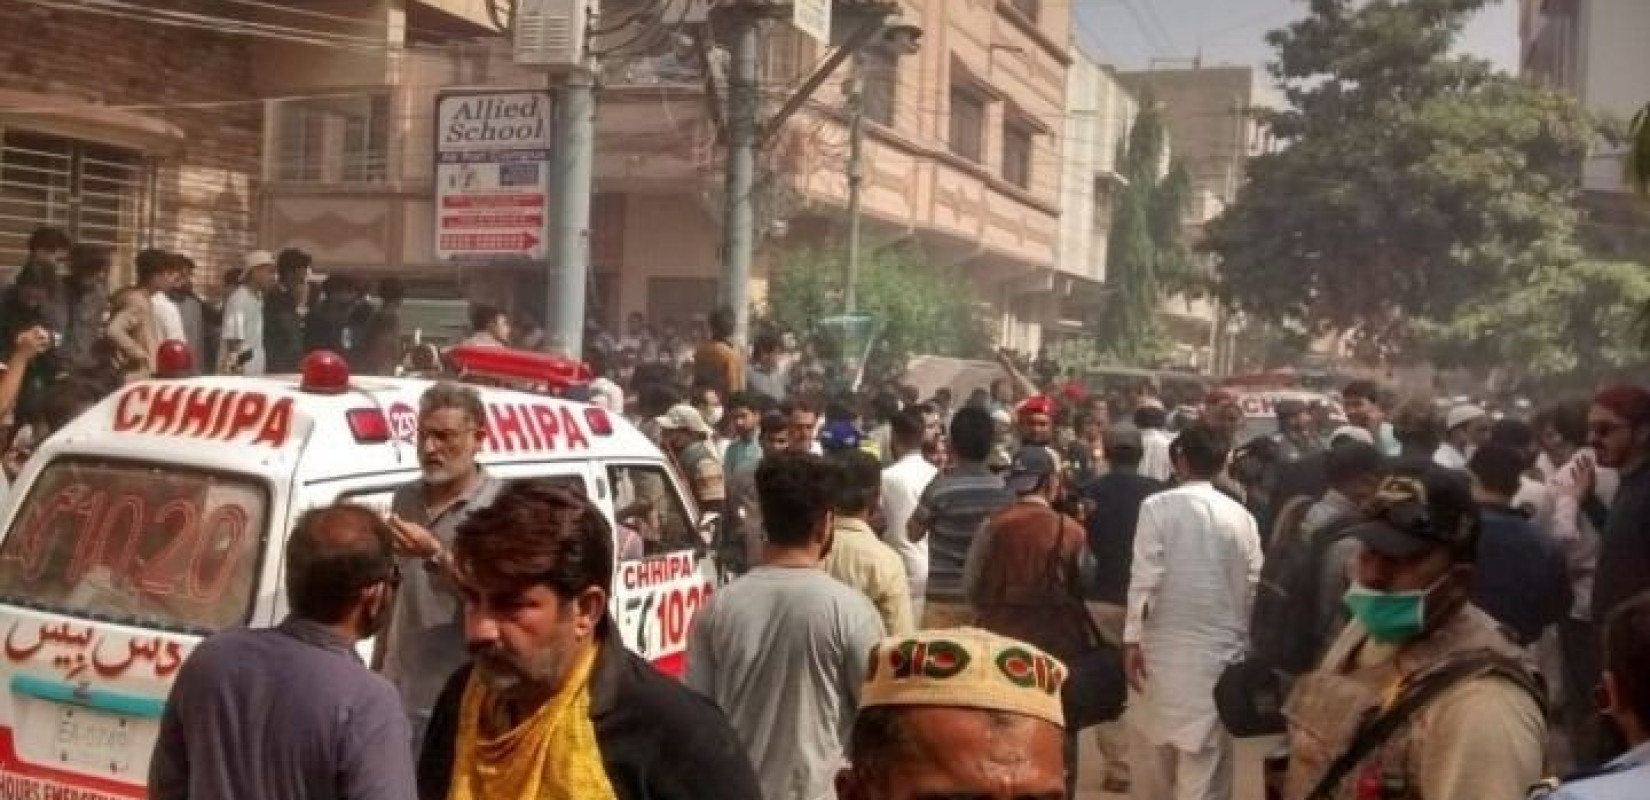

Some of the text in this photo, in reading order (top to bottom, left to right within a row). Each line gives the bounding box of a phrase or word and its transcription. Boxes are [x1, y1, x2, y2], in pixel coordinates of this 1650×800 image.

[455, 96, 539, 119] Allied
[447, 119, 542, 142] School
[113, 385, 293, 447] CHHIPA
[623, 554, 692, 590] CHHIPA
